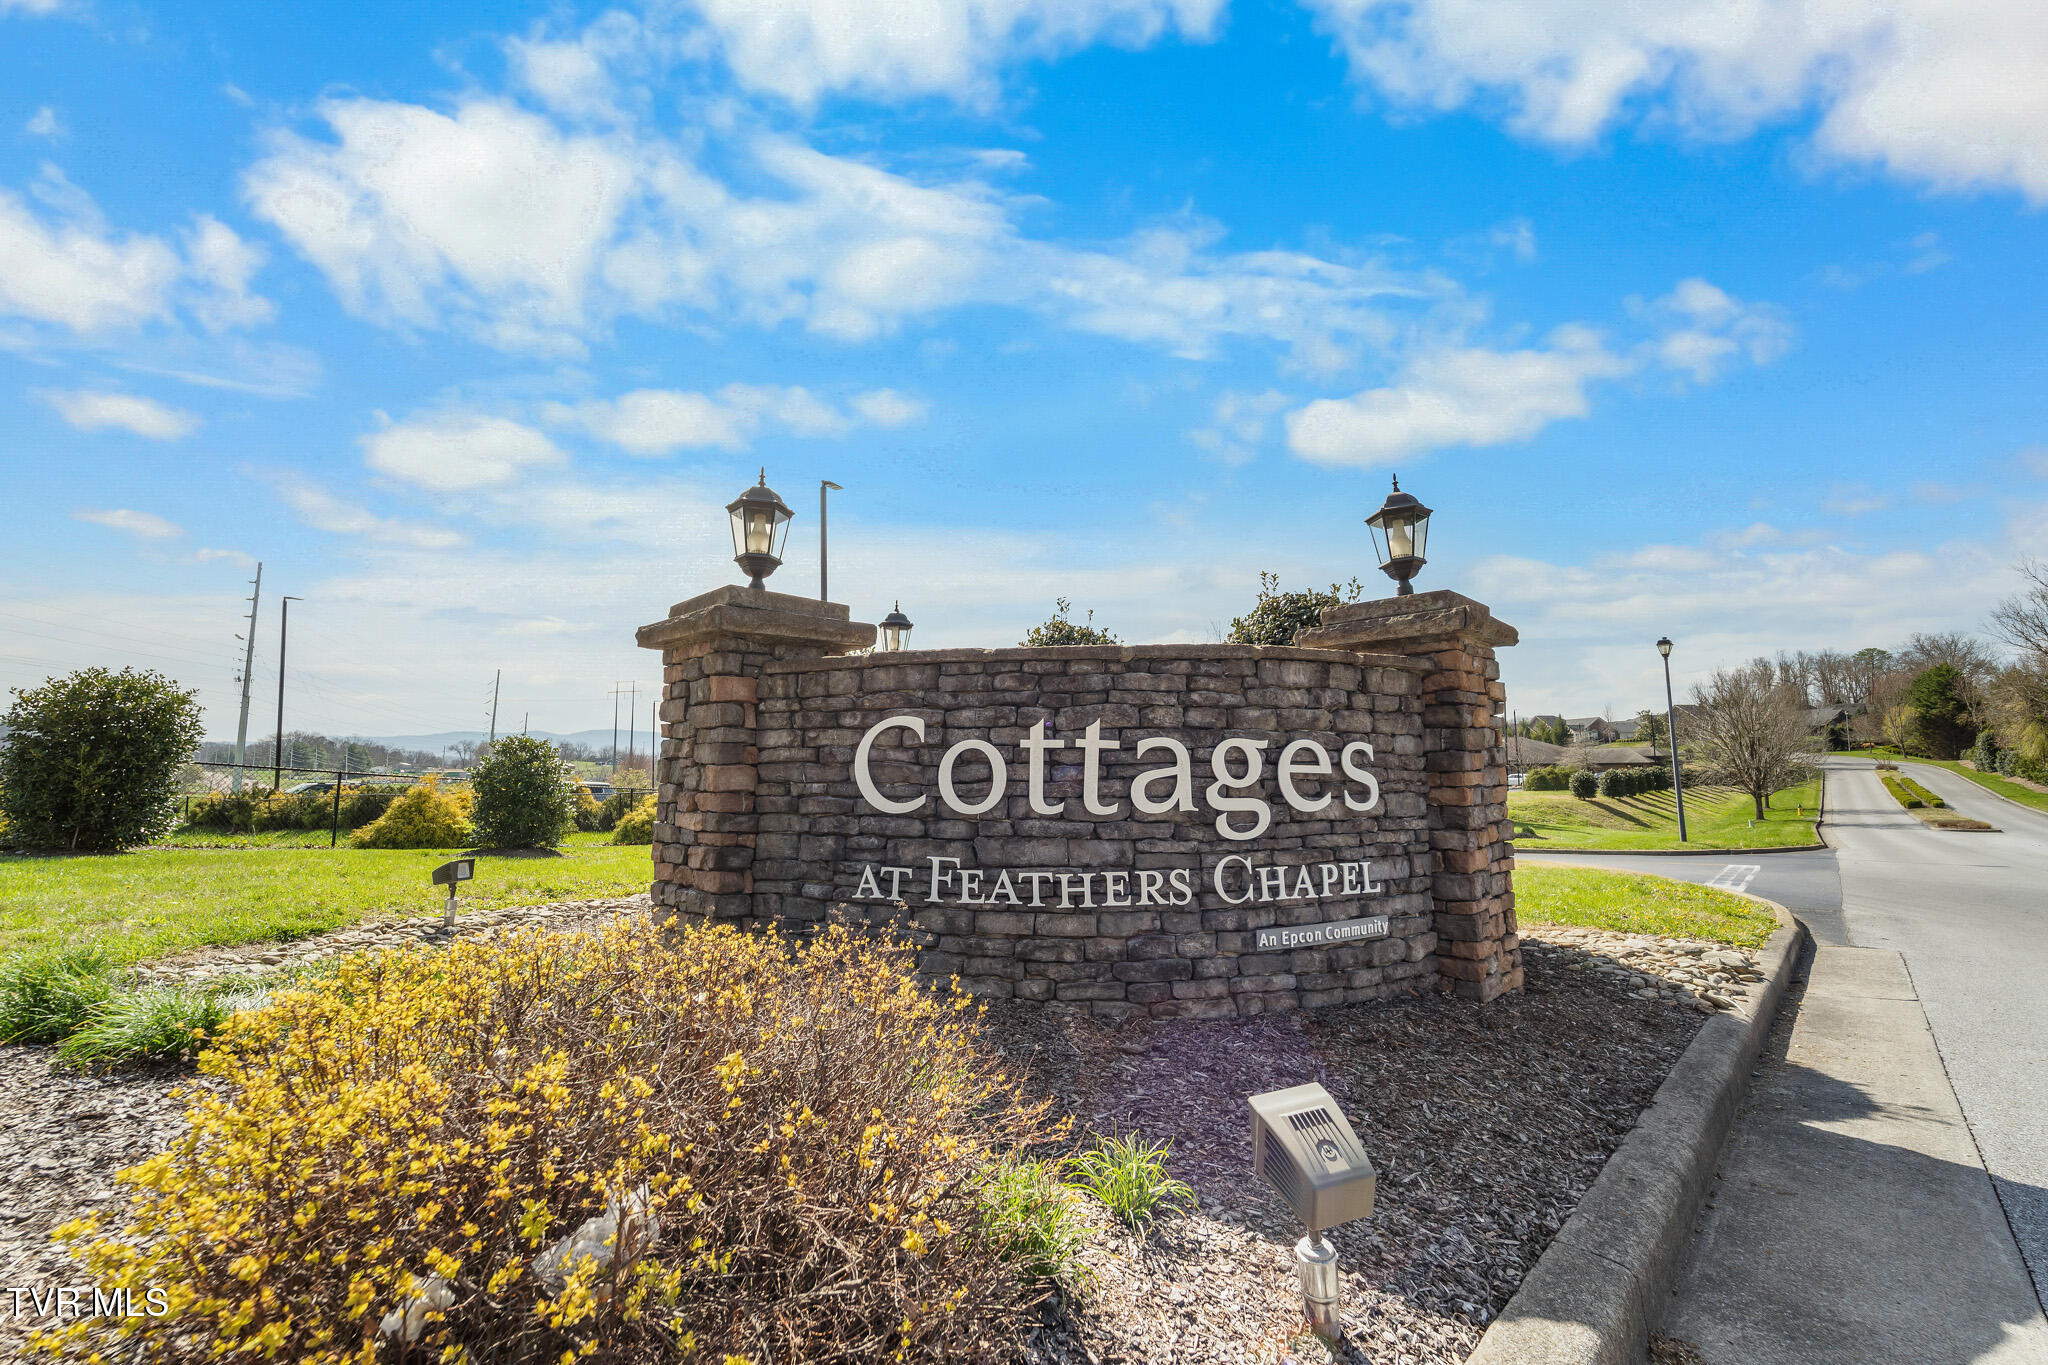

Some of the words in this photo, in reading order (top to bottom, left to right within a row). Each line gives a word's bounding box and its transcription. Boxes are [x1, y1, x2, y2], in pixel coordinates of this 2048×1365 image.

[854, 716, 1381, 840] Cottages
[852, 864, 912, 899] AT
[924, 856, 1193, 908] FEATHERS
[1213, 855, 1381, 904] CHAPEL
[1258, 933, 1277, 947] An
[1281, 930, 1322, 948] Epcon
[1325, 919, 1389, 940] Community
